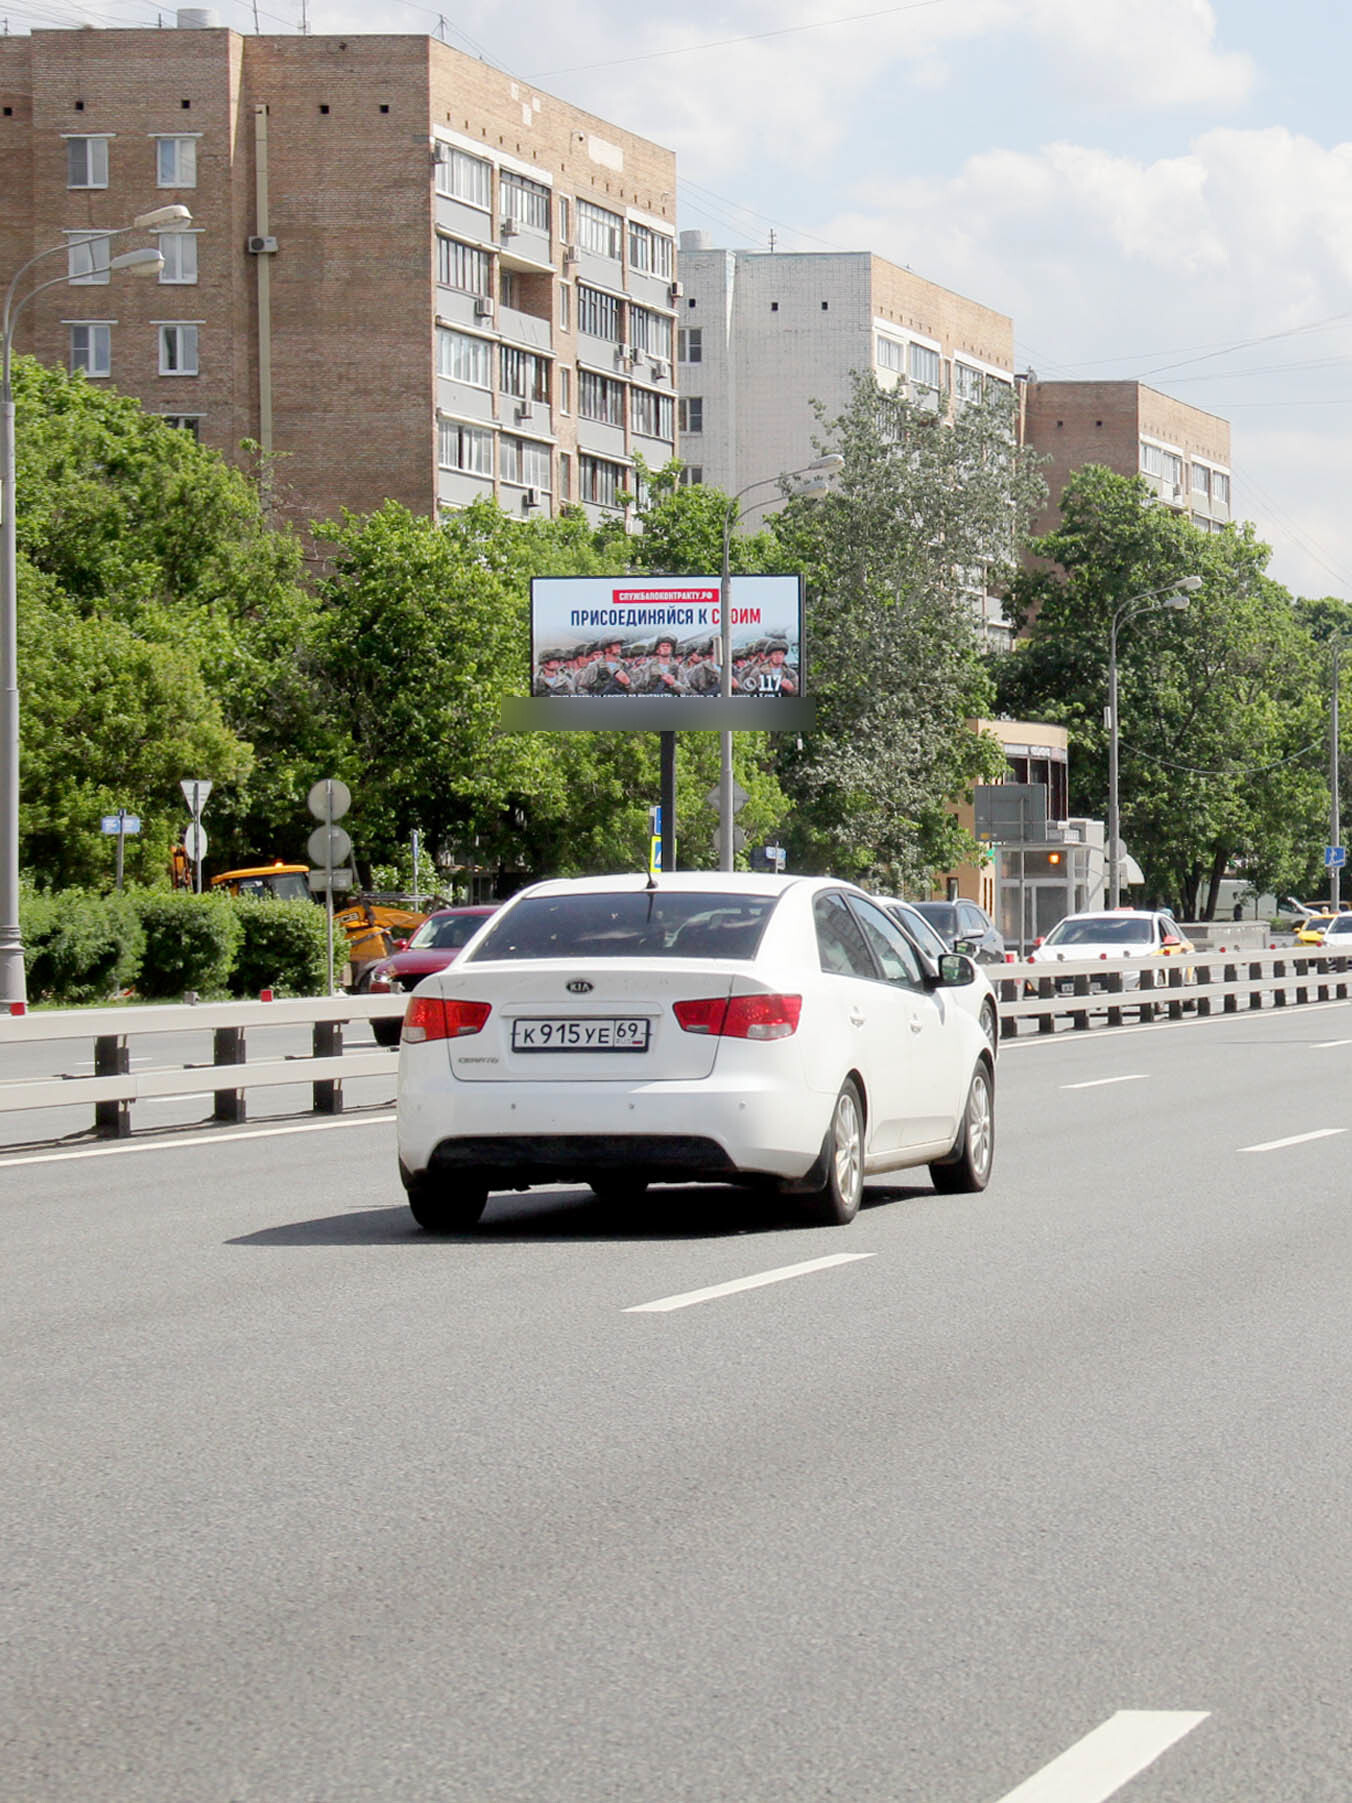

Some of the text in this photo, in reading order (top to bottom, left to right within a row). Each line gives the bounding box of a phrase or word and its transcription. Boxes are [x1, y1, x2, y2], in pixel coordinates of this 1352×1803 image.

[618, 590, 713, 601] СЛУЖБАПОКОНТРАКТУ.РФ
[571, 605, 761, 627] ПРИСОЕДИНЯЙСЯ К СОИМ
[759, 674, 782, 692] 117
[568, 981, 591, 993] KIA
[615, 1022, 639, 1038] 69
